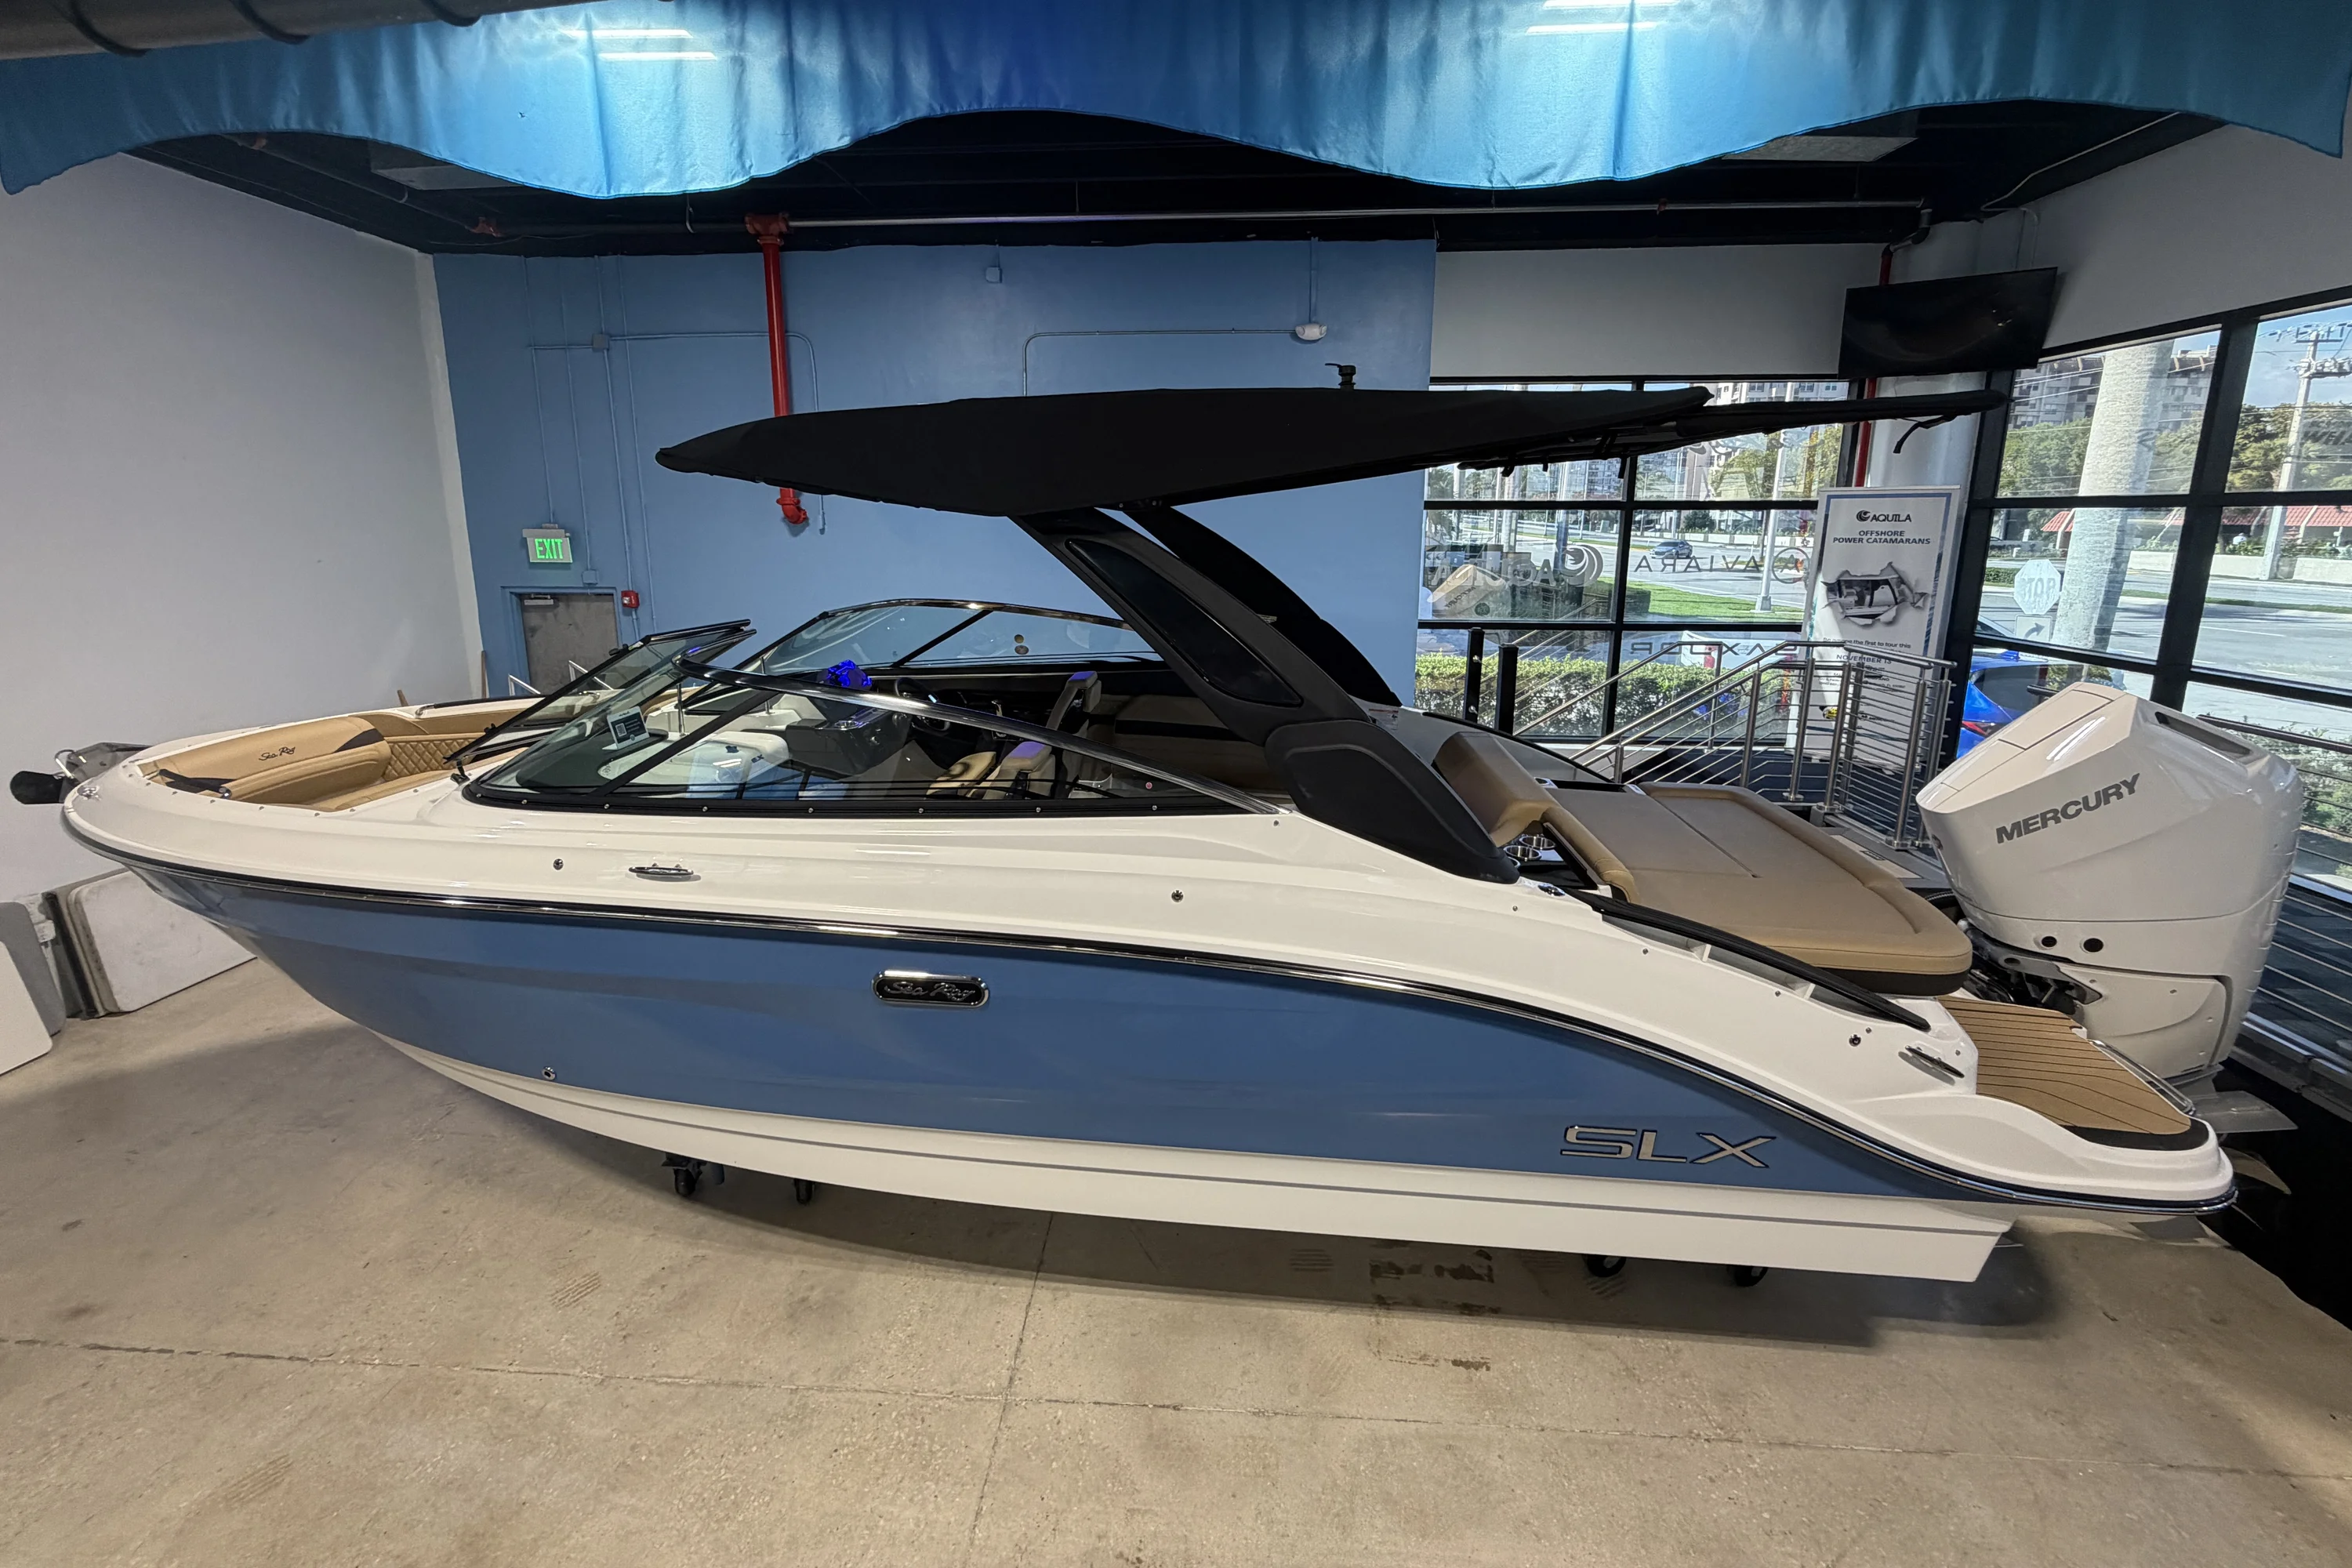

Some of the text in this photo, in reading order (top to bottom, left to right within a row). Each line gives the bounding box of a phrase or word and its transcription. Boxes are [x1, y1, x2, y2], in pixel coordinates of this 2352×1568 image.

[1870, 514, 1912, 523] AQUILA
[534, 538, 564, 560] EXIT
[1836, 655, 1882, 664] NOVEMBER
[258, 746, 296, 761] Sea Ray
[1995, 772, 2140, 844] MERCURY
[884, 981, 976, 1002] Sea Ray
[1559, 1124, 1777, 1169] SLX
